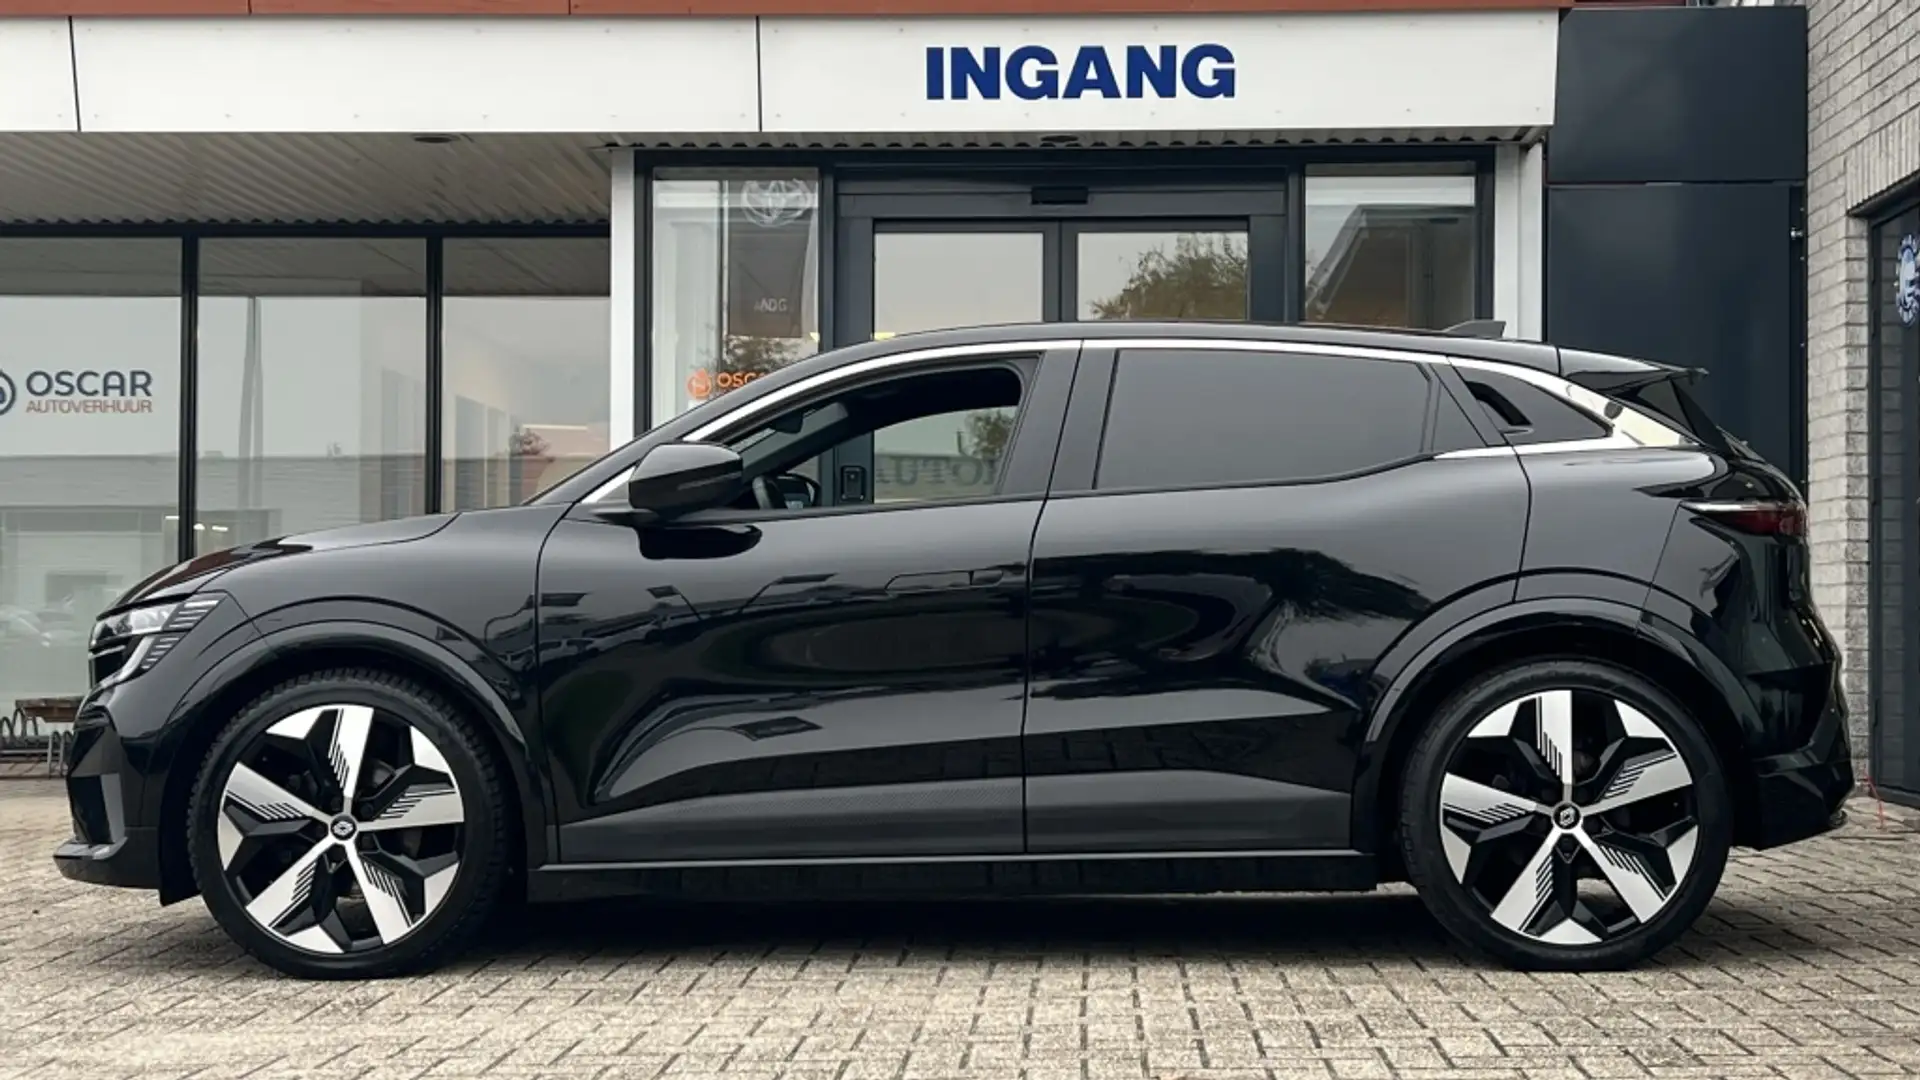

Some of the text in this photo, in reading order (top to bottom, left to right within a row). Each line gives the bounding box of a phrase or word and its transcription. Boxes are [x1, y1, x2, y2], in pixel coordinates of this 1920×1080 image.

[926, 44, 1235, 99] INGANG
[25, 370, 153, 397] OSCAR
[717, 372, 766, 387] OSC
[26, 399, 152, 413] AUTOVERHUUR
